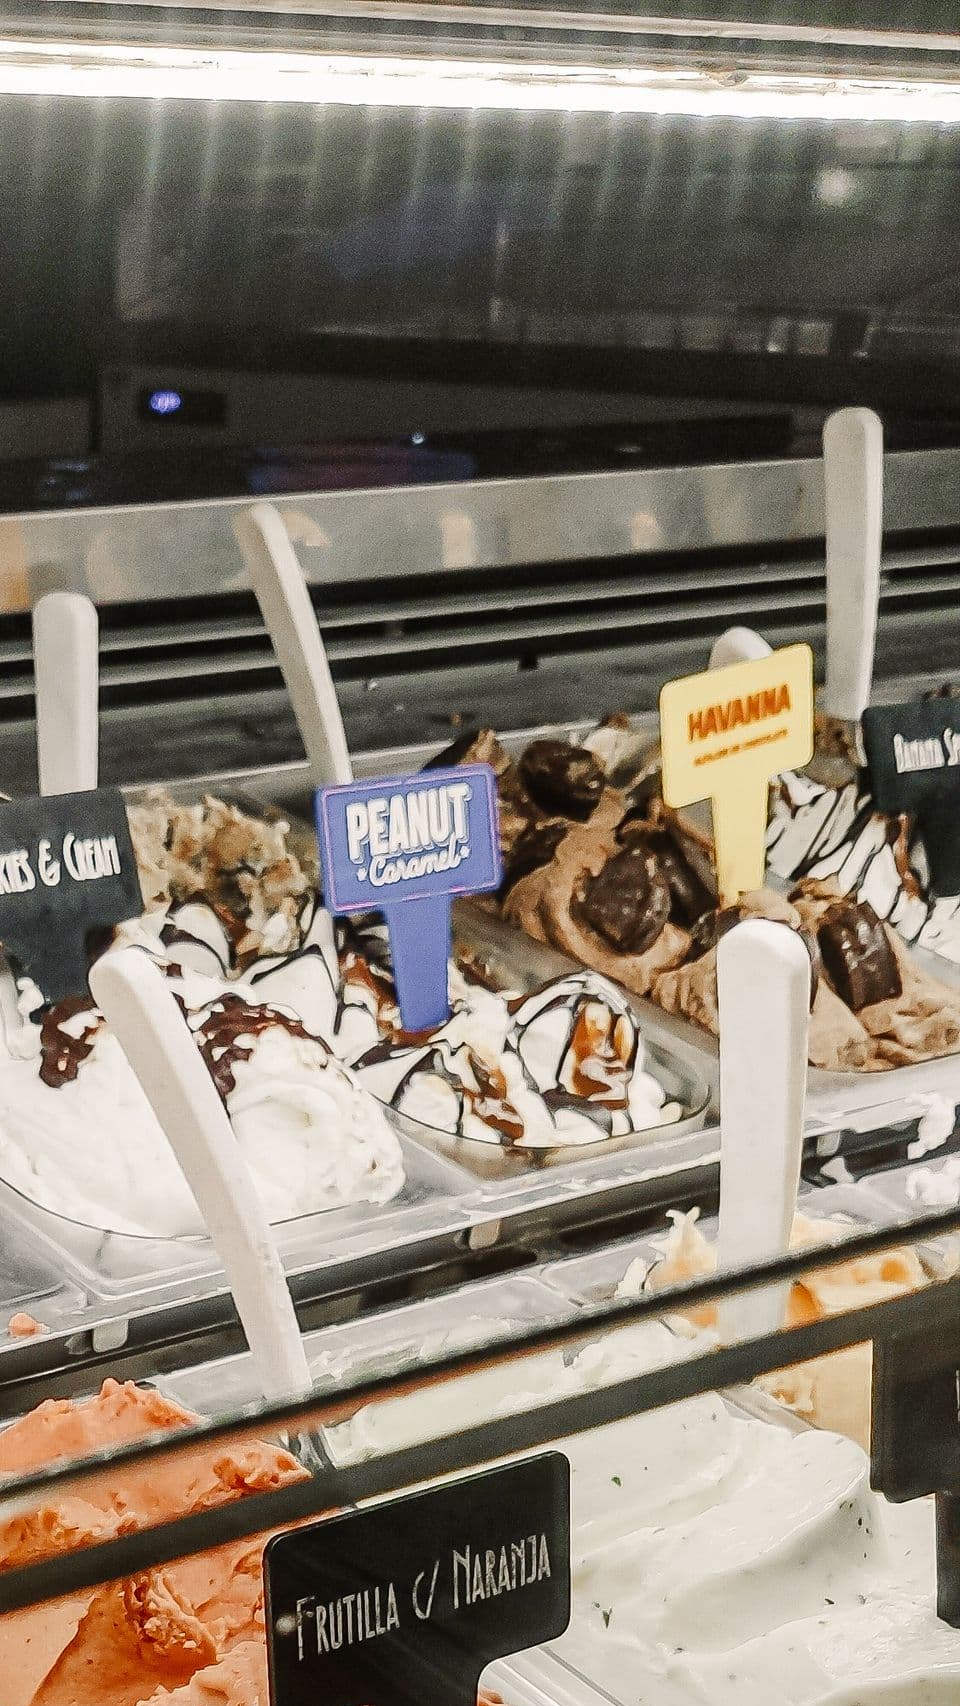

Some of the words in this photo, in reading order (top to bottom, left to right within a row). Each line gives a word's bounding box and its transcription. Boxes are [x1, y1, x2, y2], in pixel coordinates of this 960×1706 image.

[688, 684, 791, 742] HAVANNA
[346, 782, 472, 864] PEANUT
[38, 838, 61, 887] &
[63, 832, 121, 881] CREAM
[369, 831, 462, 887] Caramel
[295, 1582, 401, 1662] FRUTILLA
[452, 1533, 552, 1610] NARANJA
